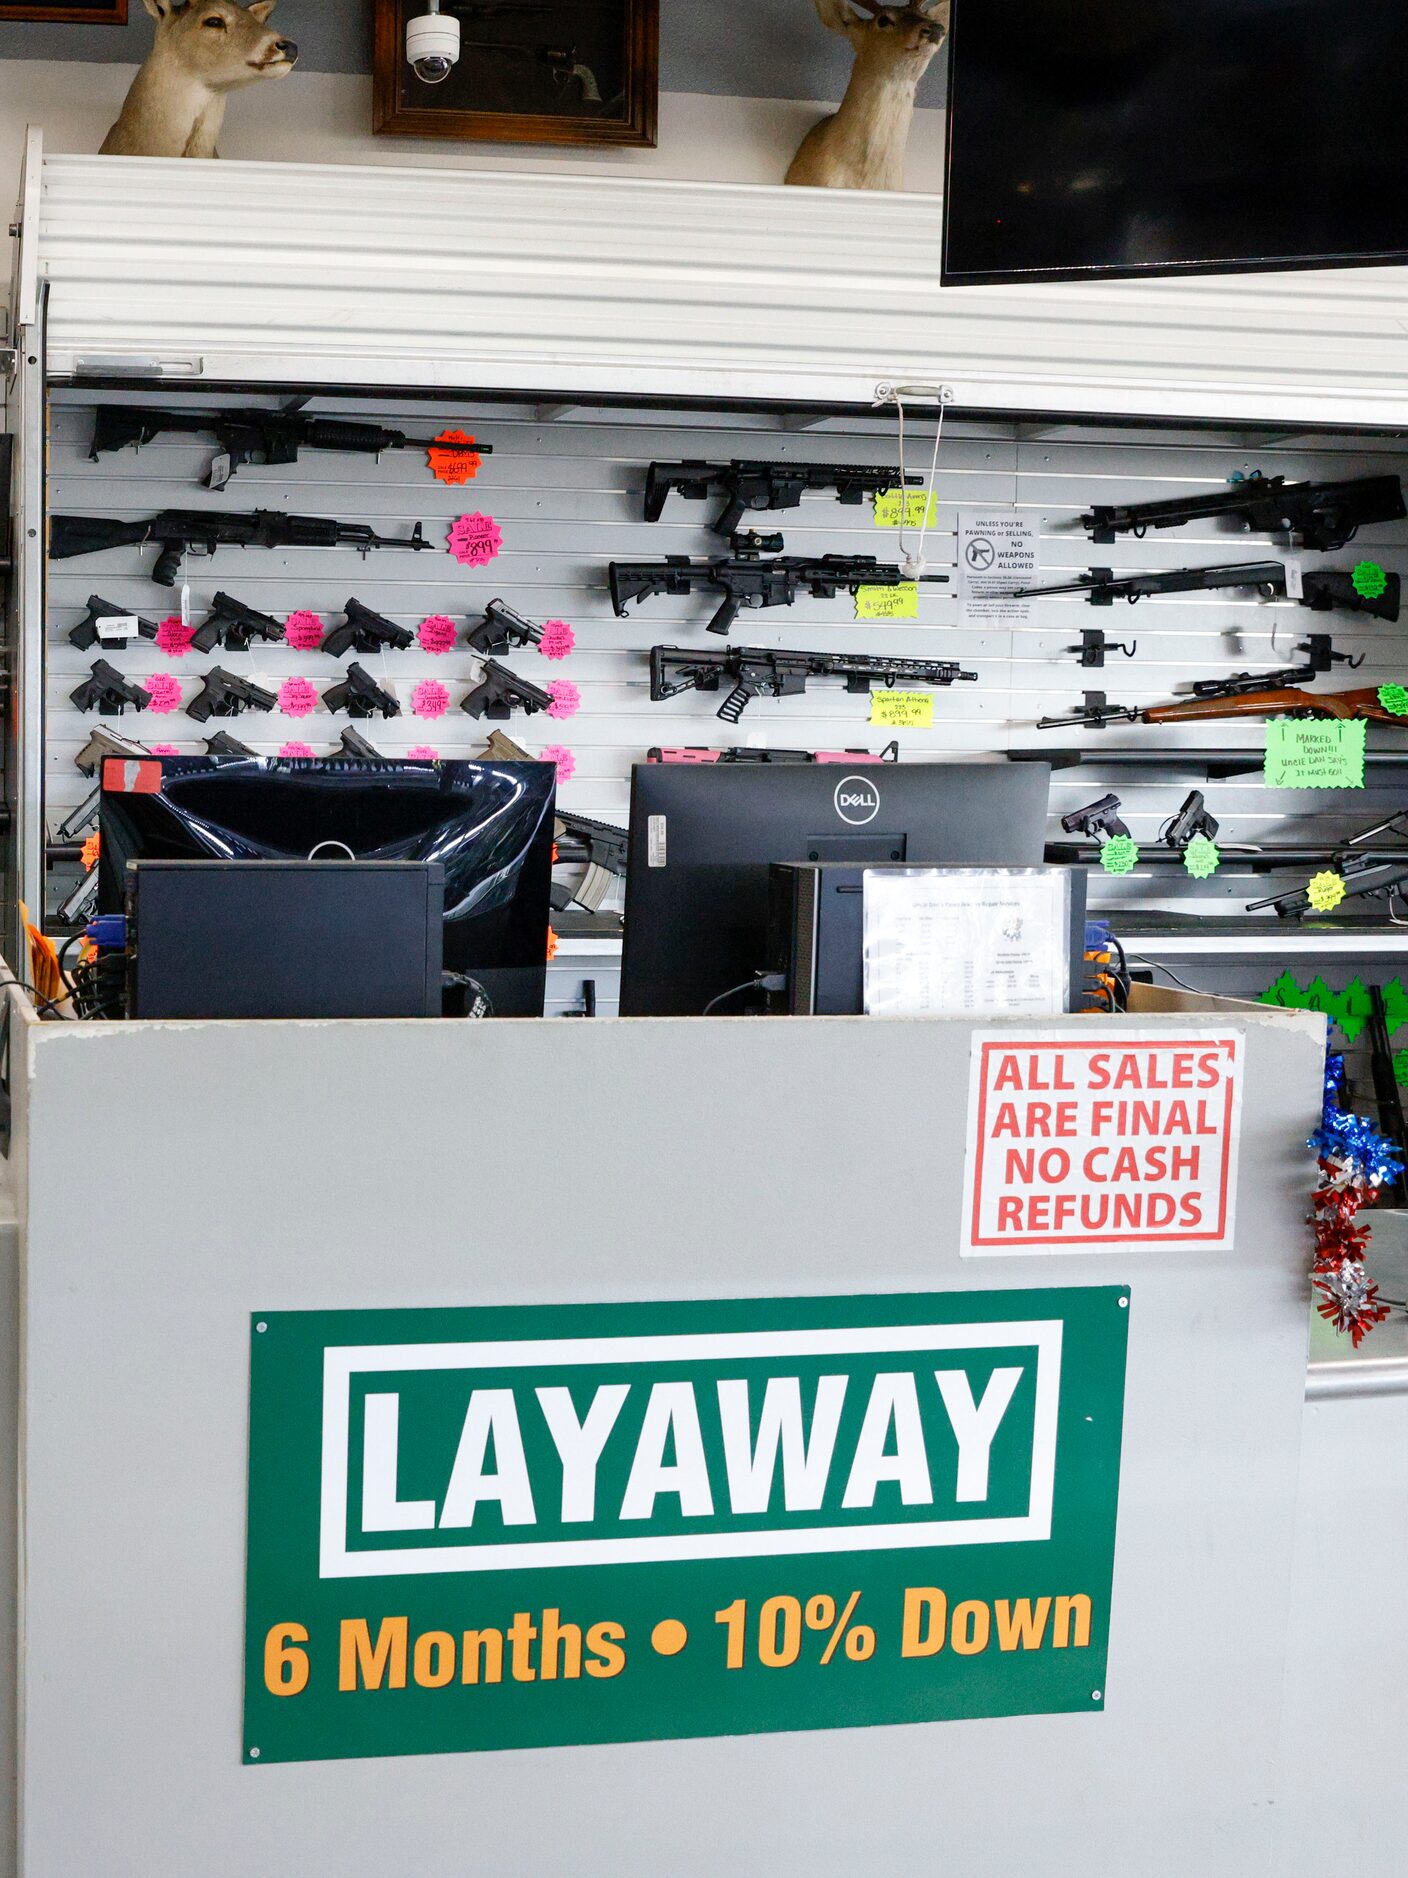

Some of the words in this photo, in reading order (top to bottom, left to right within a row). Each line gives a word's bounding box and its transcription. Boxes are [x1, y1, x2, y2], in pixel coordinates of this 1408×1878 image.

[457, 522, 493, 536] SALE
[1296, 734, 1332, 744] MARKED
[1309, 756, 1325, 765] DAN
[1328, 757, 1348, 766] SAYS
[840, 793, 876, 808] DELL
[993, 1054, 1075, 1091] ALL
[1087, 1053, 1220, 1090] SALES
[991, 1101, 1078, 1138] ARE
[1092, 1100, 1217, 1137] FINAL
[1005, 1148, 1071, 1184] NO
[1083, 1146, 1200, 1183] CASH
[998, 1192, 1202, 1232] REFUNDS
[360, 1366, 1025, 1534] LAYAWAY
[262, 1622, 311, 1699] 6
[338, 1608, 628, 1694] Months
[714, 1591, 878, 1671] 10%
[901, 1586, 1094, 1657] Down
